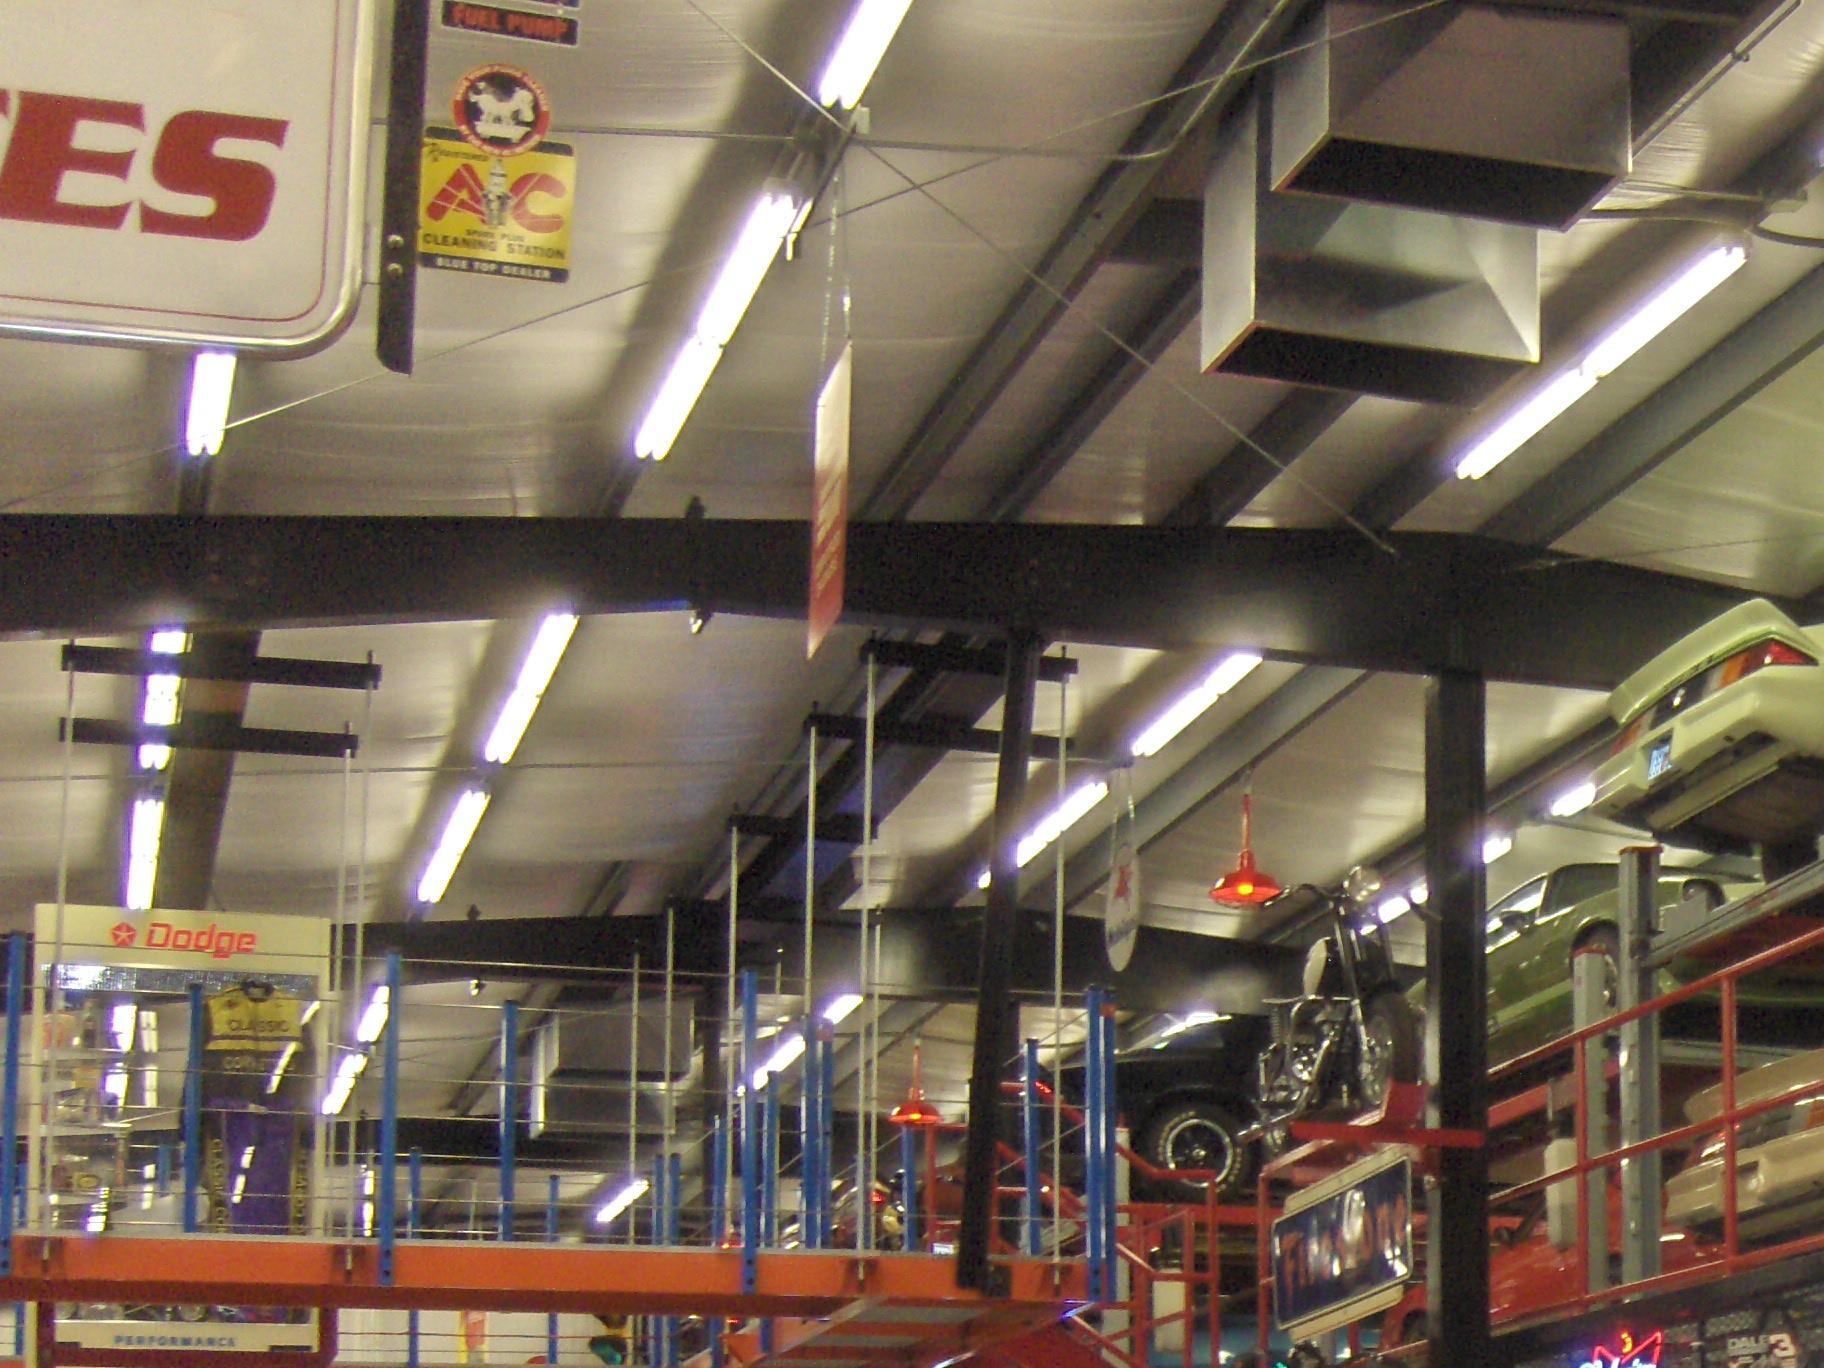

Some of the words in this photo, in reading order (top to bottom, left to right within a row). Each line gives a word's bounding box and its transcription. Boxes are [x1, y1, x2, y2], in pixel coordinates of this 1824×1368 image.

[506, 14, 568, 41] PUMP
[0, 88, 289, 242] ES
[423, 233, 497, 252] CLEANING
[507, 242, 565, 259] STATION
[145, 922, 257, 959] Dodge
[114, 1334, 236, 1347] PERFORMANCE
[1768, 1333, 1797, 1358] 3
